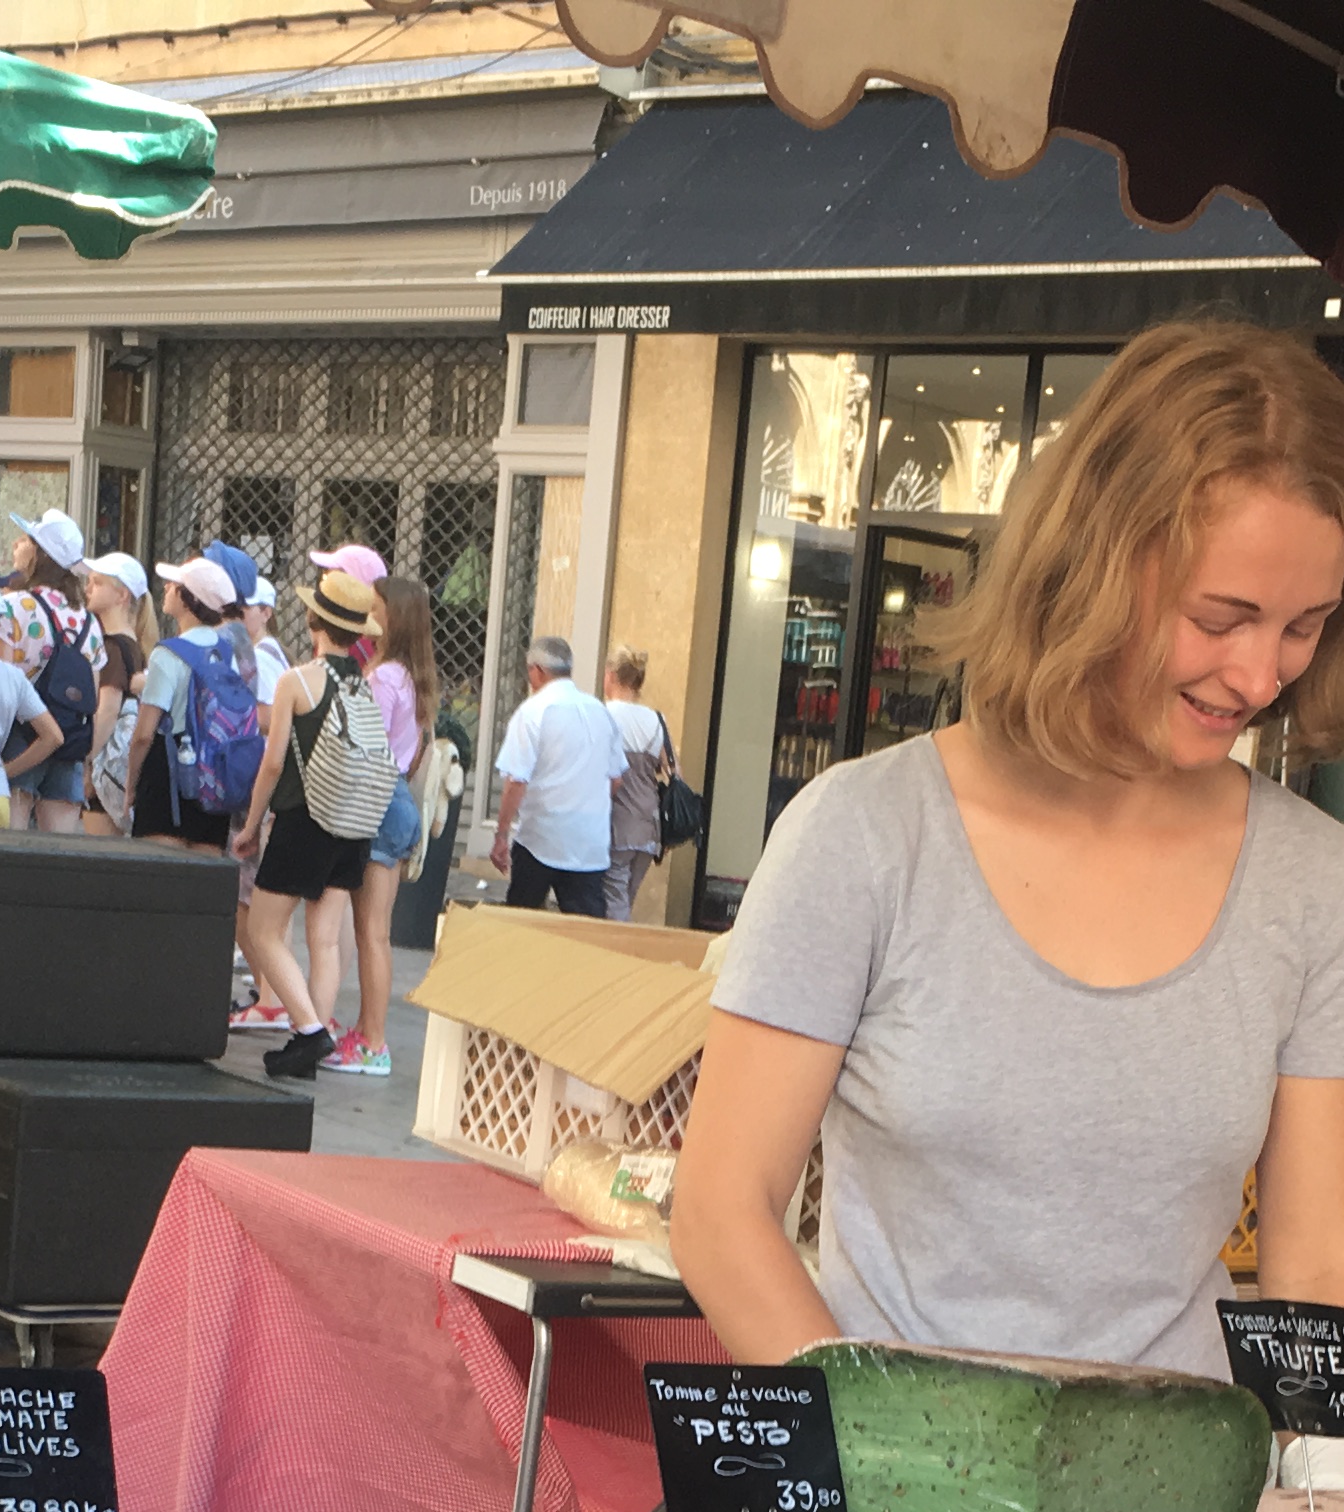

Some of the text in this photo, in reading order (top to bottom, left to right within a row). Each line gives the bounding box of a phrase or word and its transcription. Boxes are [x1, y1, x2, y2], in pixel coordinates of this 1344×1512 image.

[470, 179, 567, 210] Depuis 1918
[528, 306, 581, 329] COIFFEUR
[589, 306, 616, 329] HAIR
[617, 305, 671, 329] DRESSER
[650, 1378, 813, 1405] Tomme de vache
[721, 1402, 750, 1418] au
